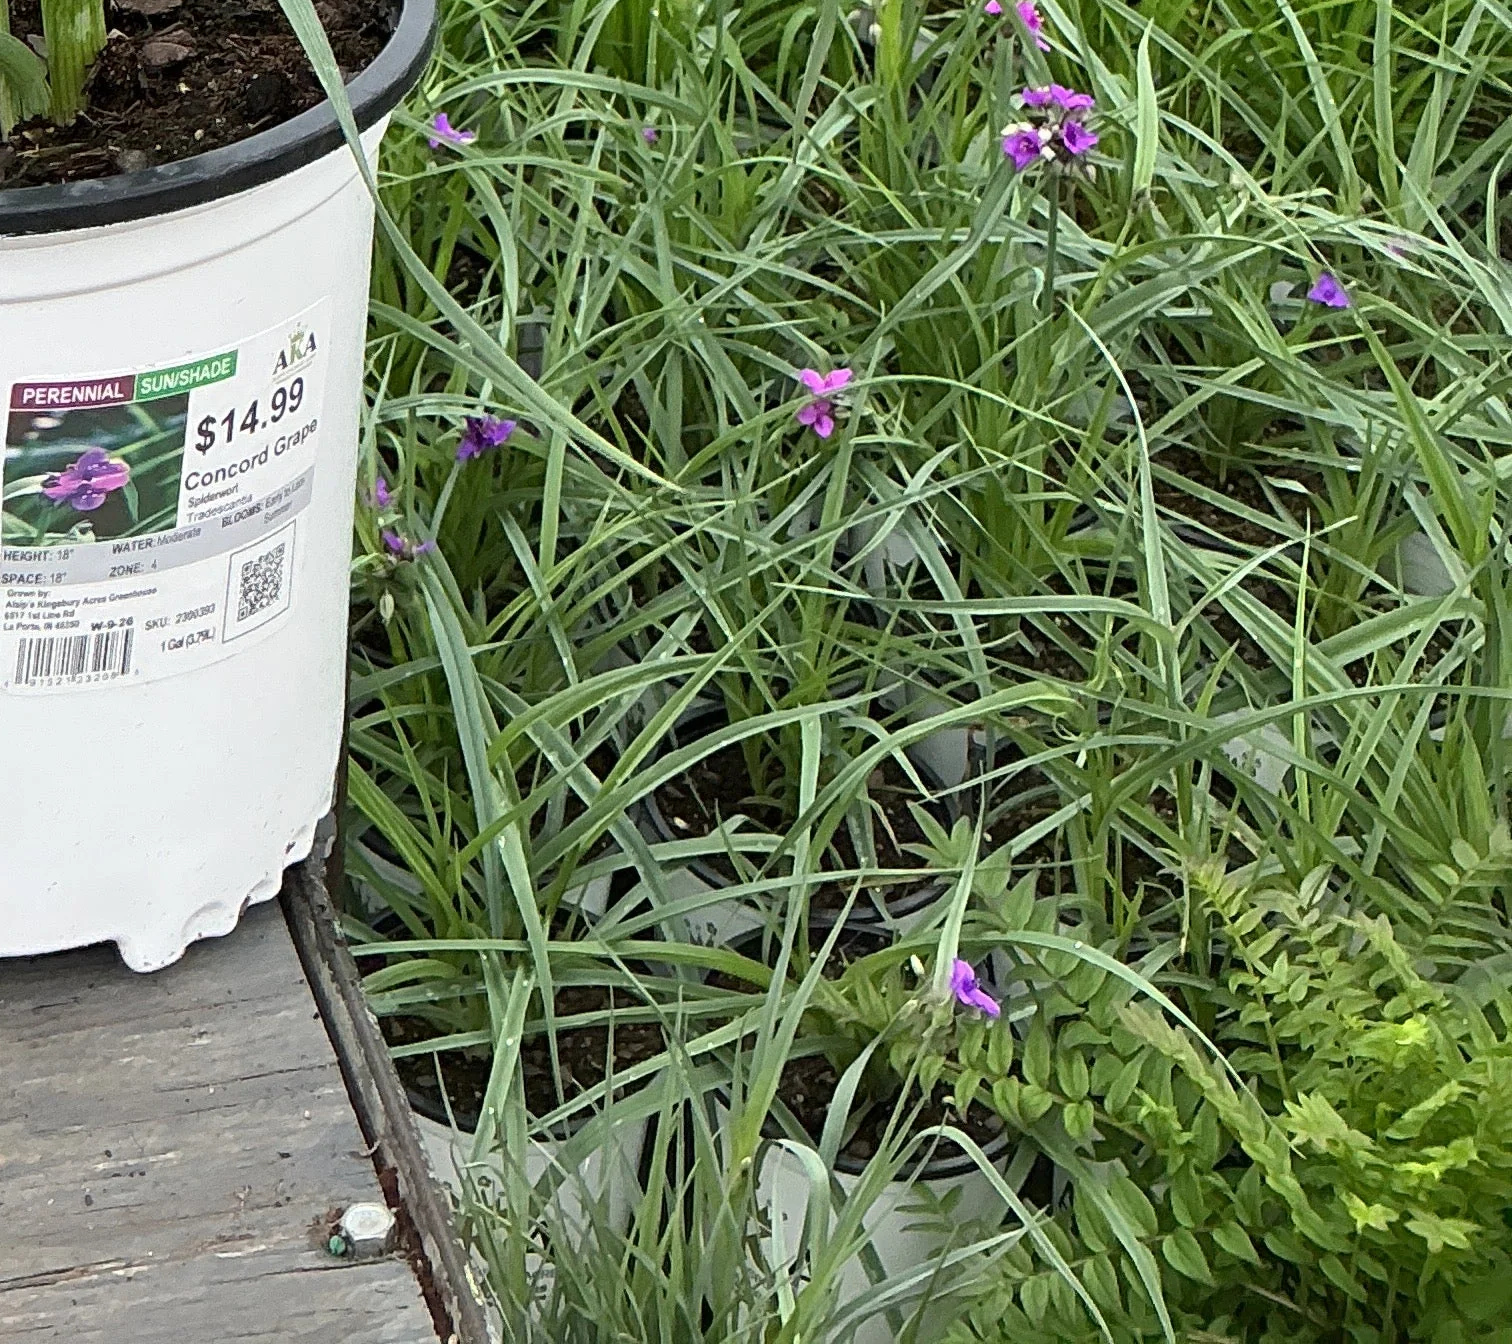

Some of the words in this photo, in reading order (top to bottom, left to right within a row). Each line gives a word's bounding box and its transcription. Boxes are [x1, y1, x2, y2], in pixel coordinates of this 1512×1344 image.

[271, 332, 318, 376] AKA
[140, 356, 232, 394] SUN/SHADE
[22, 381, 125, 404] PERENNIAL
[194, 376, 305, 456] $14.99
[184, 445, 270, 491] Concord
[273, 418, 319, 458] Grape
[187, 482, 240, 509] Spiderwort
[221, 501, 263, 529] BLOOMS:
[111, 538, 156, 555] WATER:
[157, 526, 202, 545] Moderate
[3, 549, 53, 562] HEIGHT:
[57, 548, 75, 561] 18"
[1, 573, 47, 585] SPACE:
[50, 572, 67, 584] 18"
[109, 562, 145, 578] ZONE:
[150, 559, 158, 570] 4
[38, 598, 81, 611] Kingsbury
[82, 595, 107, 606] Acres
[108, 587, 158, 602] Greenhouse
[144, 617, 171, 631] SKU:
[167, 634, 185, 651] Gal
